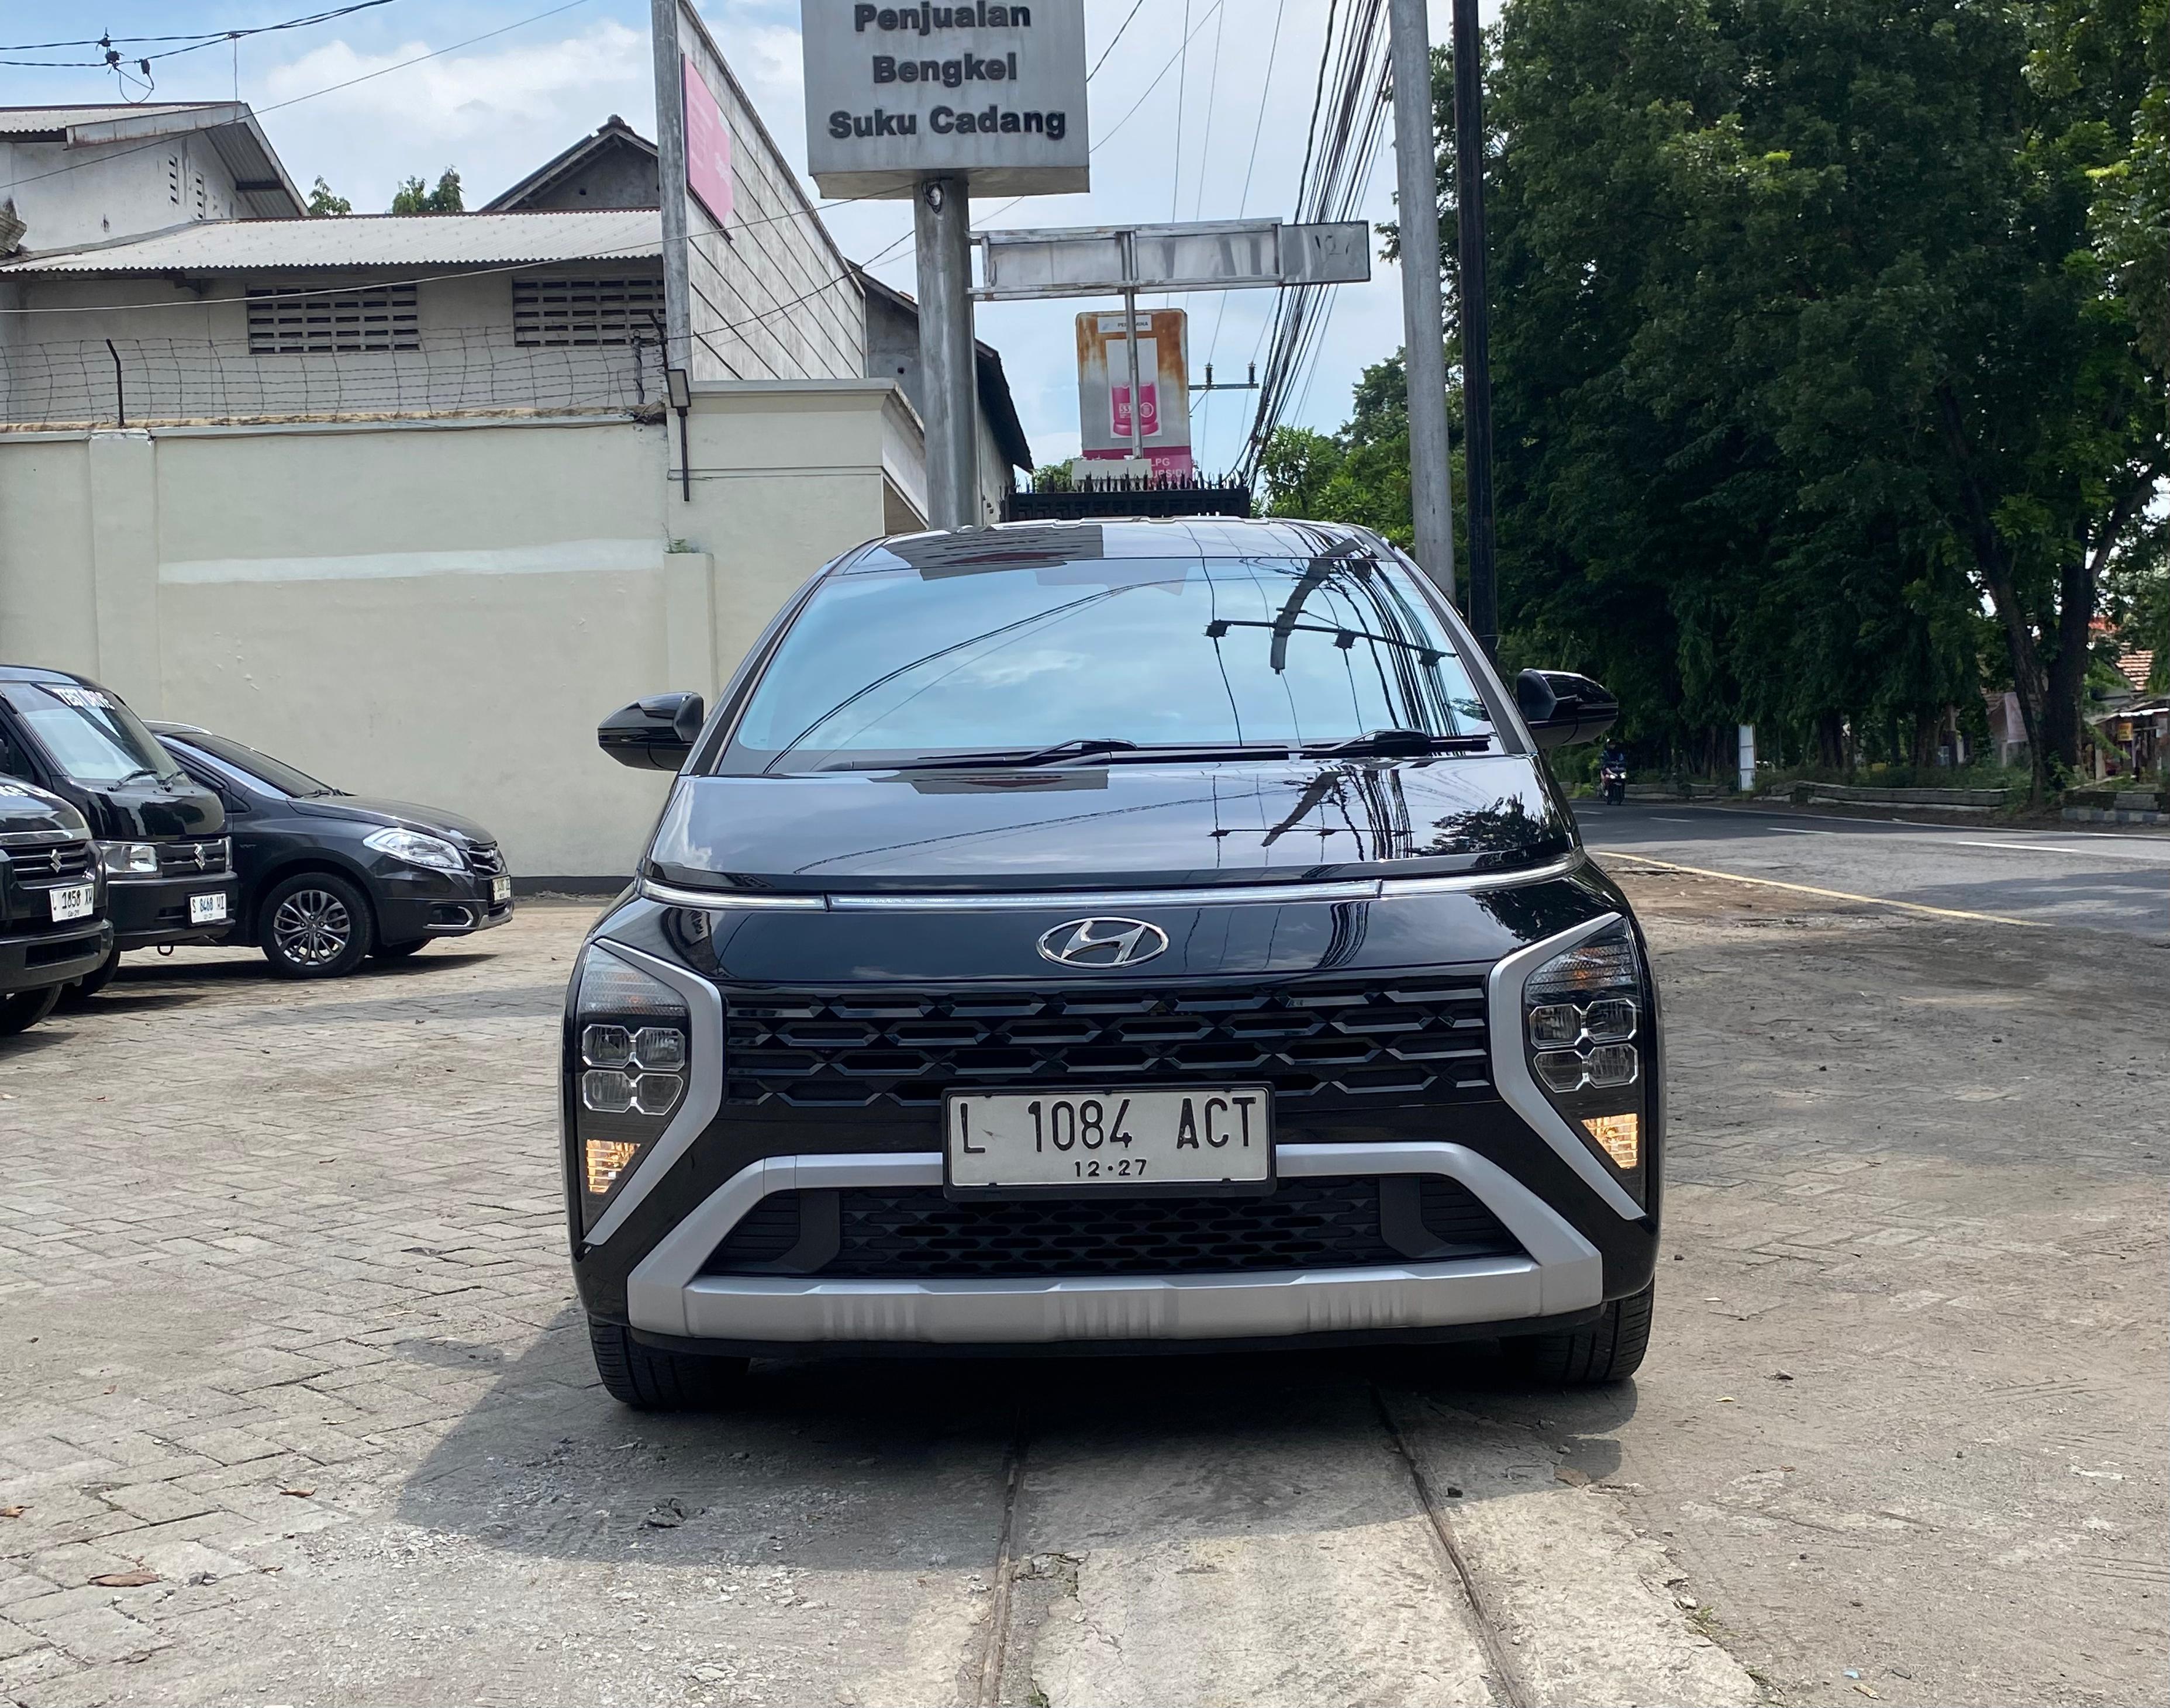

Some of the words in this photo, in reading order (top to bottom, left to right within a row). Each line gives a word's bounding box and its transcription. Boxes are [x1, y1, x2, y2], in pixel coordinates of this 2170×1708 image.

[854, 1, 1030, 36] Penjualan
[872, 52, 1017, 88] Bengkel
[829, 109, 917, 139] Suku
[929, 105, 1066, 140] Cadang
[51, 688, 88, 707] TEST
[62, 890, 81, 909] 1858
[960, 1103, 985, 1153] L
[1028, 1099, 1133, 1153] 1084
[1177, 1097, 1257, 1149] ACT
